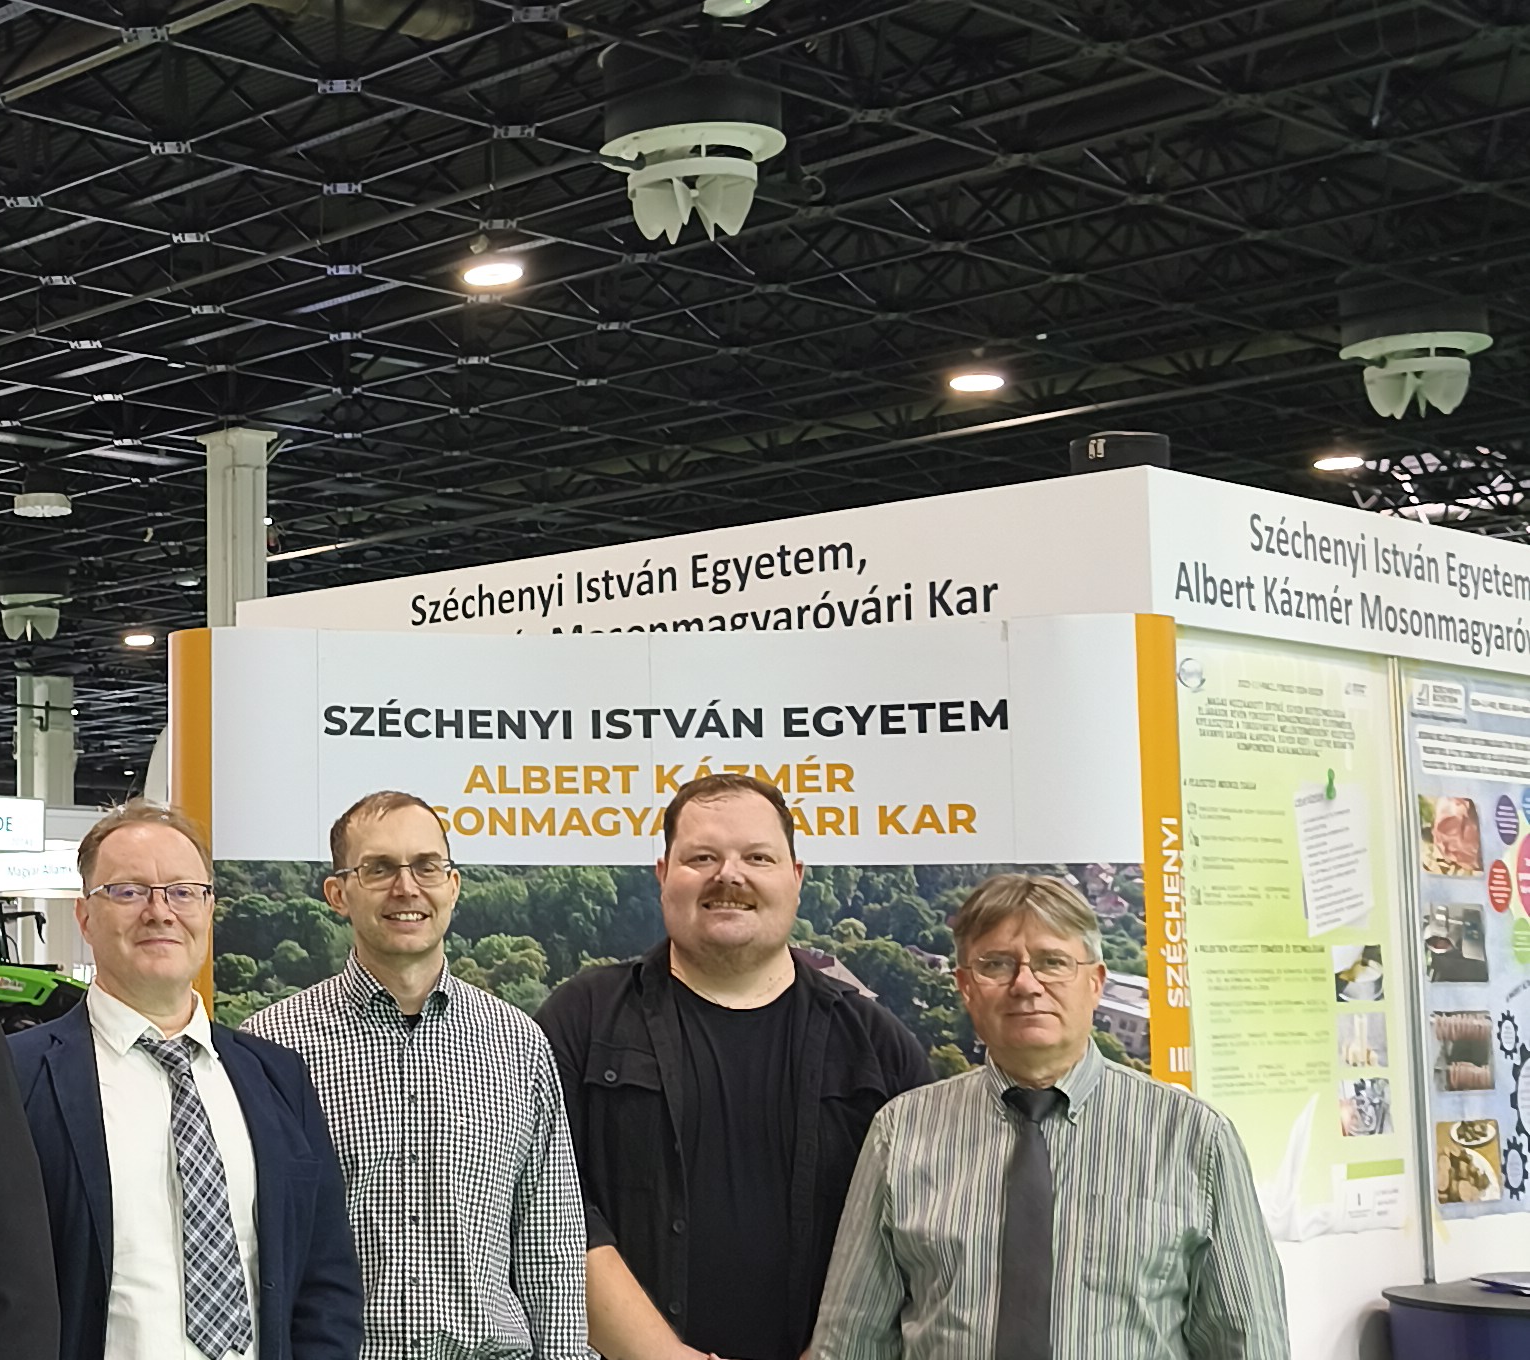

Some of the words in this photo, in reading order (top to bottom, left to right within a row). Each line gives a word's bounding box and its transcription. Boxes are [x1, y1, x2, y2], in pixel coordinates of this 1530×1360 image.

[1249, 513, 1367, 578] Széchenyi
[1373, 537, 1440, 584] István
[411, 572, 565, 627] Széchenyi
[576, 558, 677, 604] István
[691, 540, 867, 595] Egyetem,
[929, 578, 999, 619] Kar
[1175, 560, 1256, 612] Albert
[1263, 575, 1353, 627] Kázmér
[323, 698, 572, 740] SZÉCHENYI
[591, 698, 764, 739] ISTVÁN
[782, 698, 1009, 738] EGYETEM
[463, 764, 640, 794] ALBERT
[877, 803, 978, 836] KAR
[1159, 816, 1184, 1008] SZÉCHENYI
